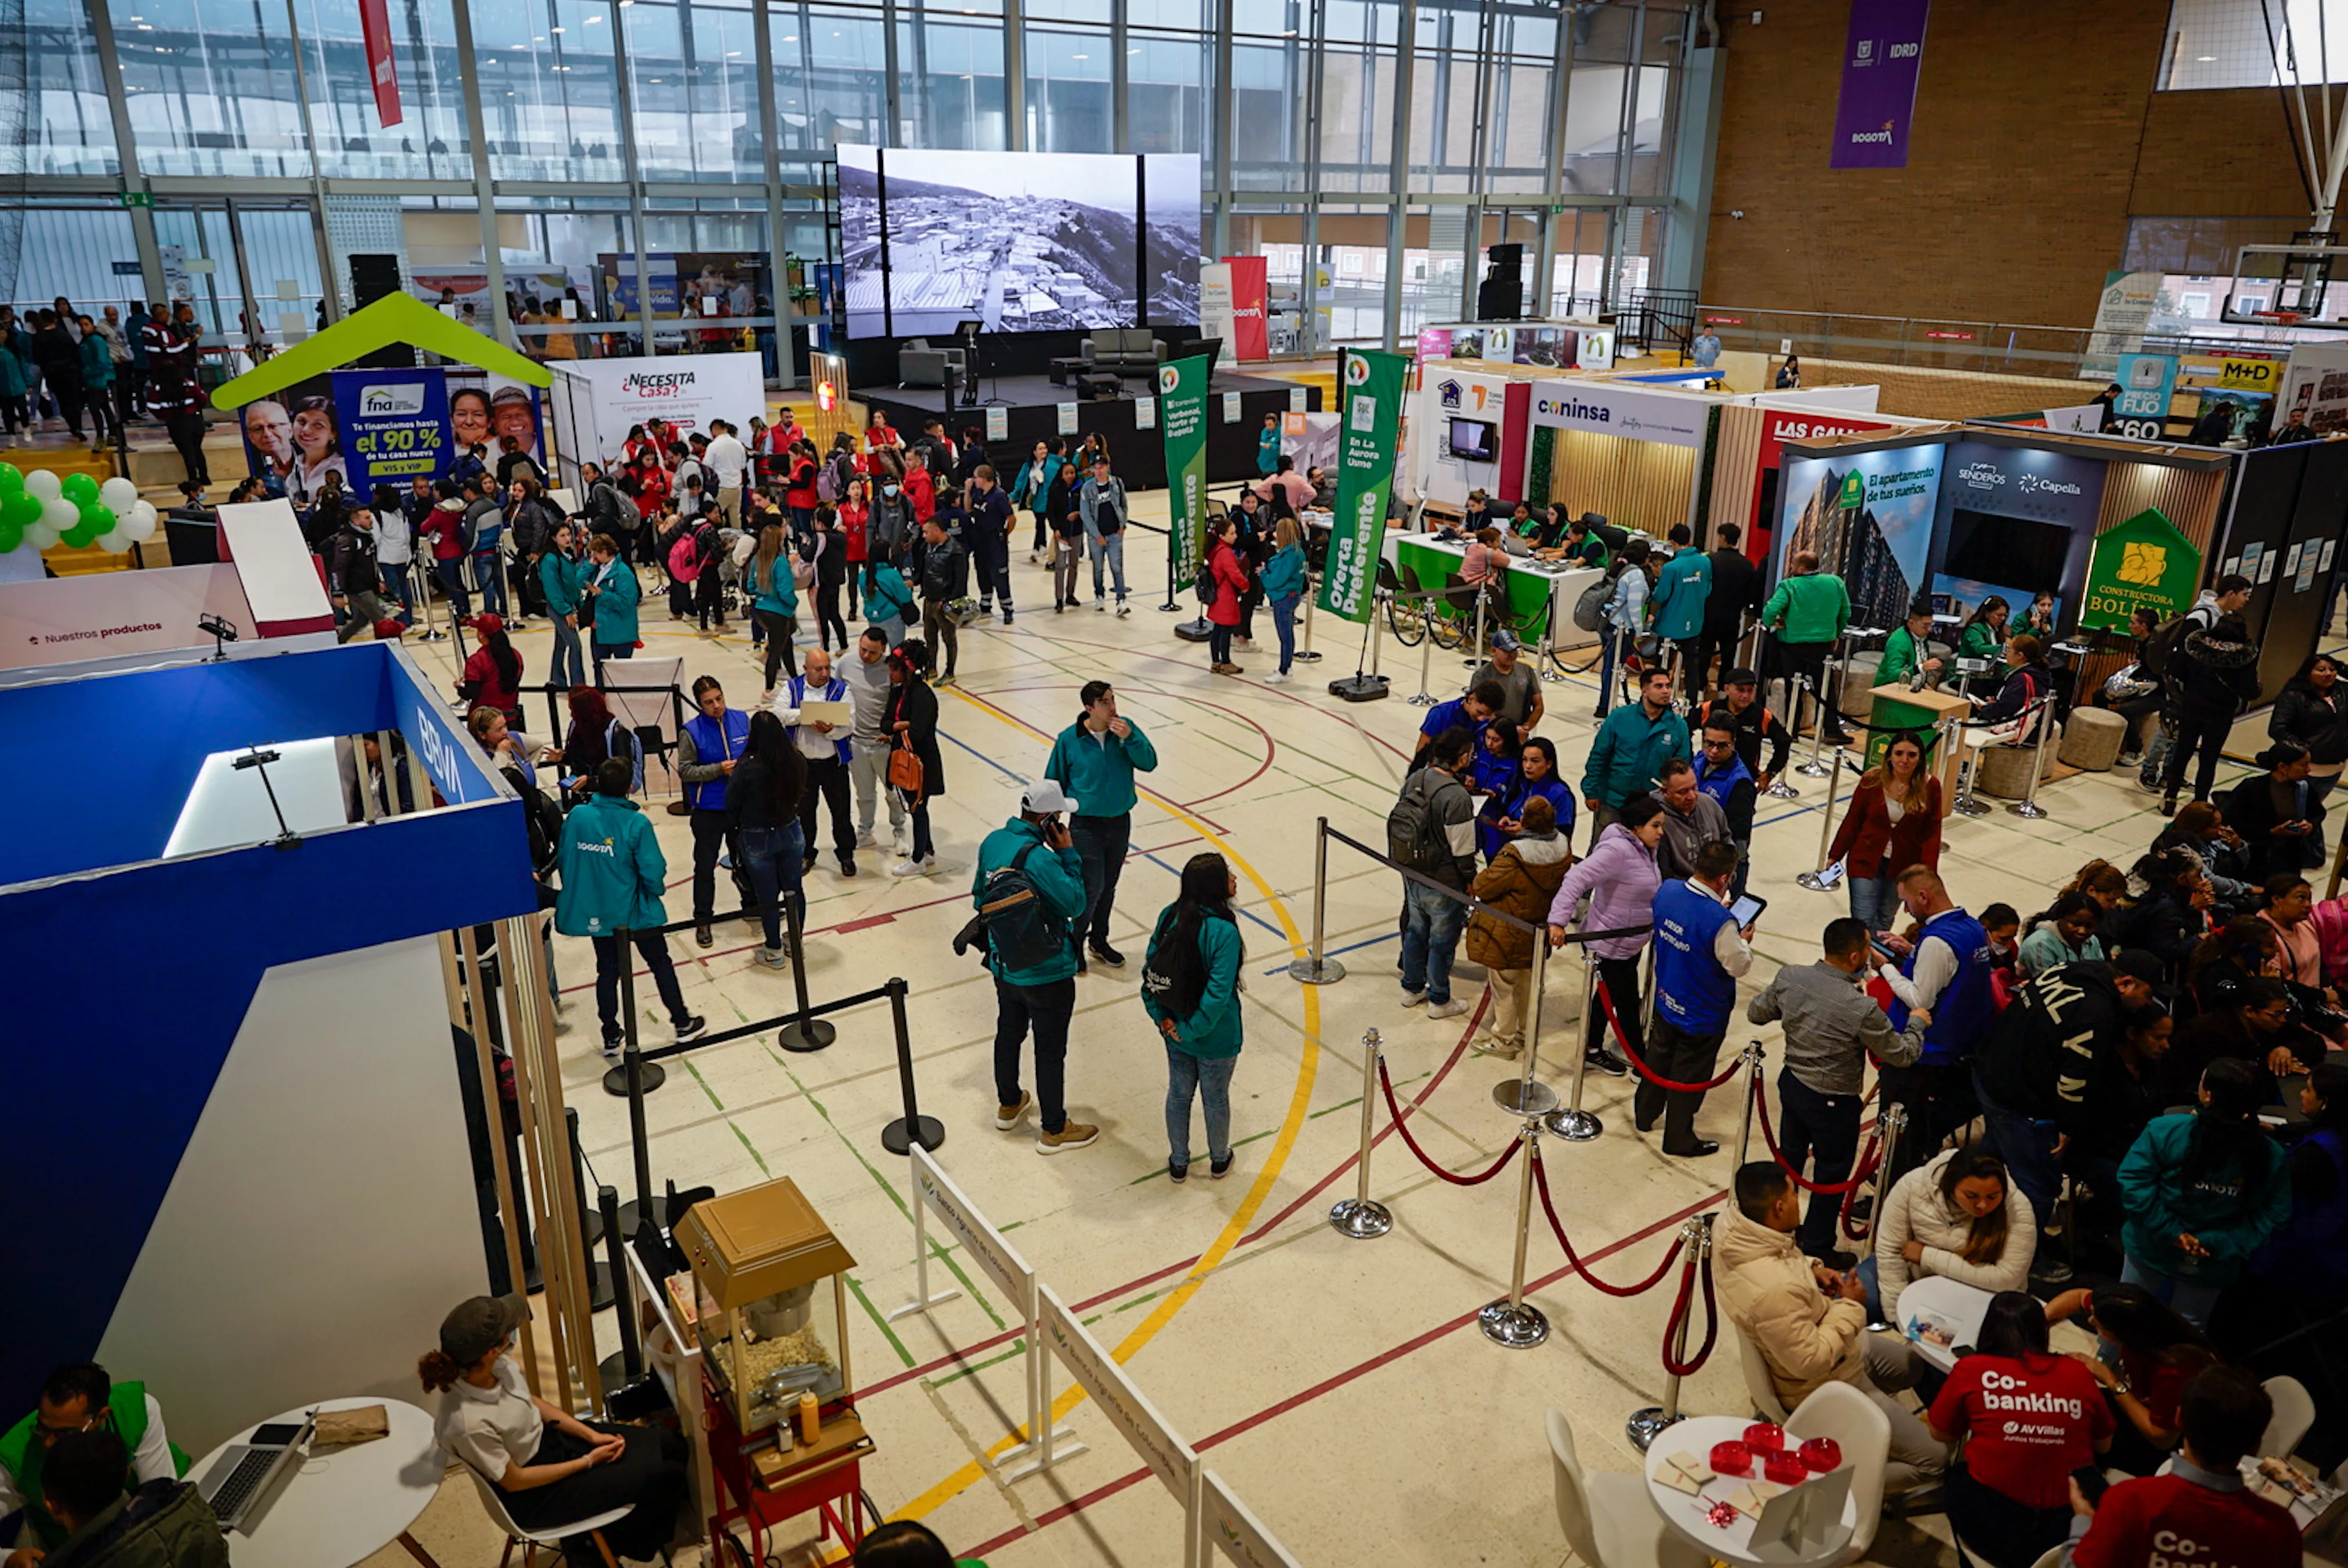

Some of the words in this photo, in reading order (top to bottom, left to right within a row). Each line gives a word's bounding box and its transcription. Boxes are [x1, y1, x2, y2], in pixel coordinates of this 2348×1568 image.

[1889, 43, 1918, 58] IDRD
[2224, 362, 2270, 380] M+D
[2125, 390, 2161, 401] PRECIO
[367, 398, 392, 412] fna
[1538, 397, 1610, 422] coninsa
[2122, 399, 2160, 413] FIJO
[352, 423, 363, 431] Te
[364, 422, 415, 431] financiamos
[416, 420, 439, 428] hasta
[1189, 416, 1199, 424] de
[1776, 420, 1808, 438] LAS
[356, 431, 377, 453] el
[383, 430, 415, 451] 90
[419, 428, 442, 449] %
[1350, 437, 1361, 447] En
[1362, 438, 1375, 449] La
[409, 449, 434, 458] nueva
[1348, 447, 1380, 460] Aurora
[383, 464, 398, 473] VIS
[407, 463, 422, 471] VIP
[1346, 458, 1372, 469] Usme
[1869, 474, 1878, 487] El
[1879, 467, 1934, 485] apartamento
[1958, 469, 2006, 485] SENDEROS
[1867, 489, 1878, 502] de
[1880, 487, 1893, 499] tus
[1894, 484, 1926, 498] sueños.
[2039, 479, 2081, 495] Capella
[1342, 492, 1377, 615] Preferente
[1330, 538, 1353, 608] Oferta
[2099, 585, 2174, 606] CONSTRUCTORA
[45, 630, 98, 644] Nuestros
[100, 622, 162, 638] productos
[416, 706, 465, 805] BBVA
[936, 1190, 956, 1217] Banco
[955, 1214, 979, 1244] Agrario
[979, 1241, 987, 1254] de
[1070, 1344, 1093, 1378] Banco
[1094, 1375, 1124, 1414] Agrario
[1124, 1411, 1135, 1428] de
[1981, 1370, 2027, 1390] Co-
[1983, 1390, 2082, 1420] banking
[2020, 1424, 2036, 1435] AV
[2036, 1424, 2066, 1436] Villas
[2153, 1529, 2211, 1556] Co-
